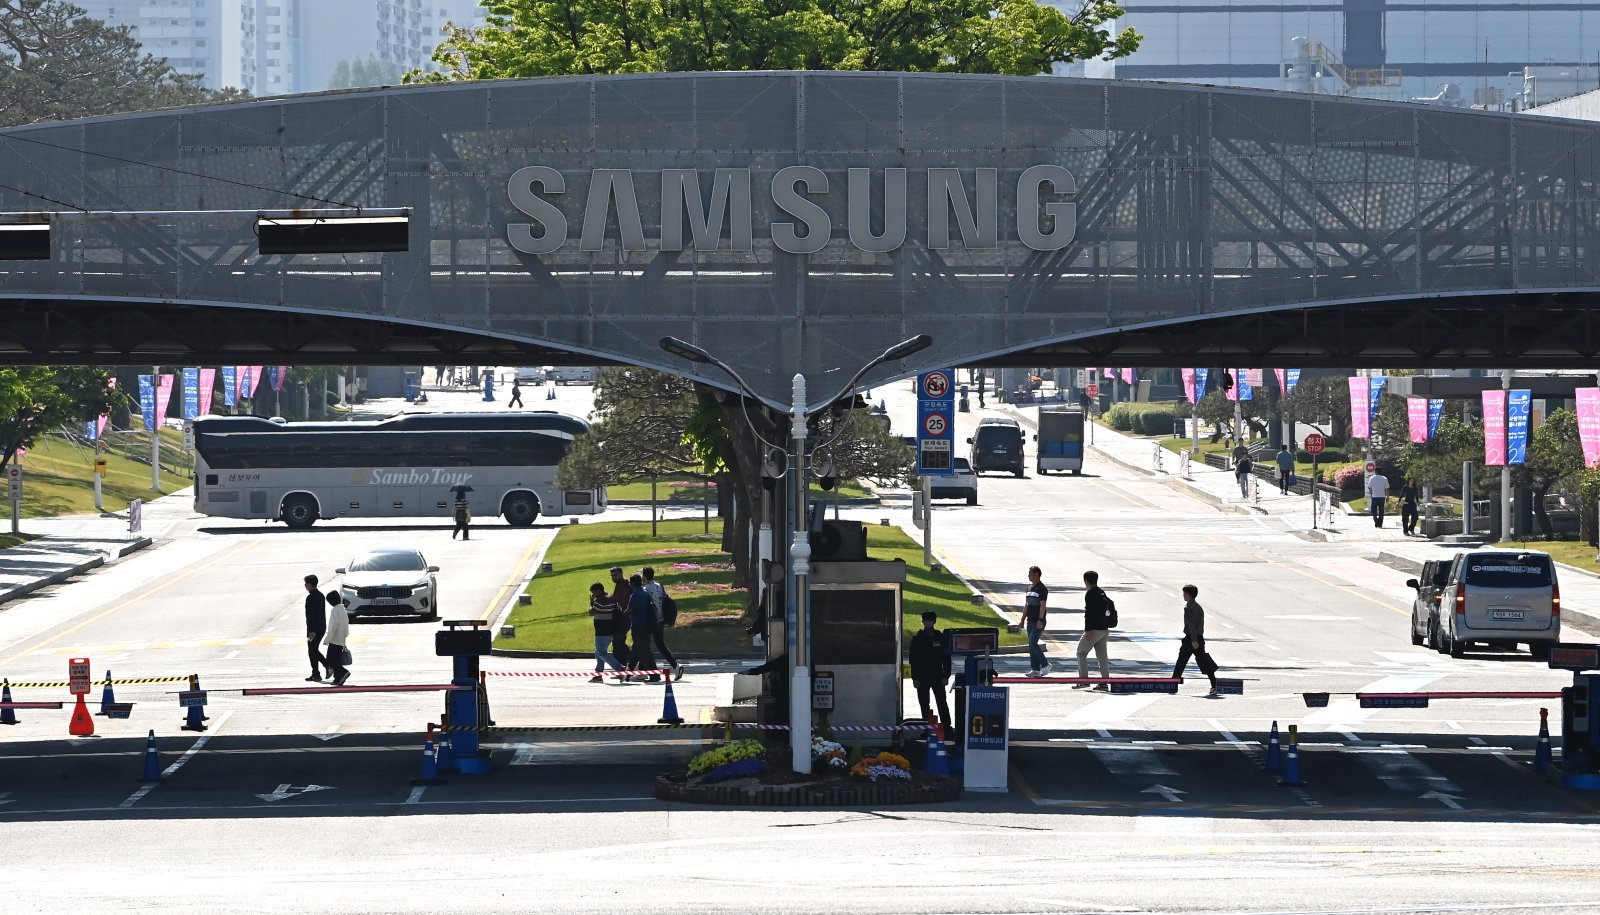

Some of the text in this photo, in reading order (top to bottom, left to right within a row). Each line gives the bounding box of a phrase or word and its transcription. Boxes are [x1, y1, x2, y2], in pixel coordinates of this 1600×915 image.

[507, 165, 1077, 253] SAMSUNG
[929, 420, 943, 430] 25
[370, 468, 473, 485] Sambo Tour
